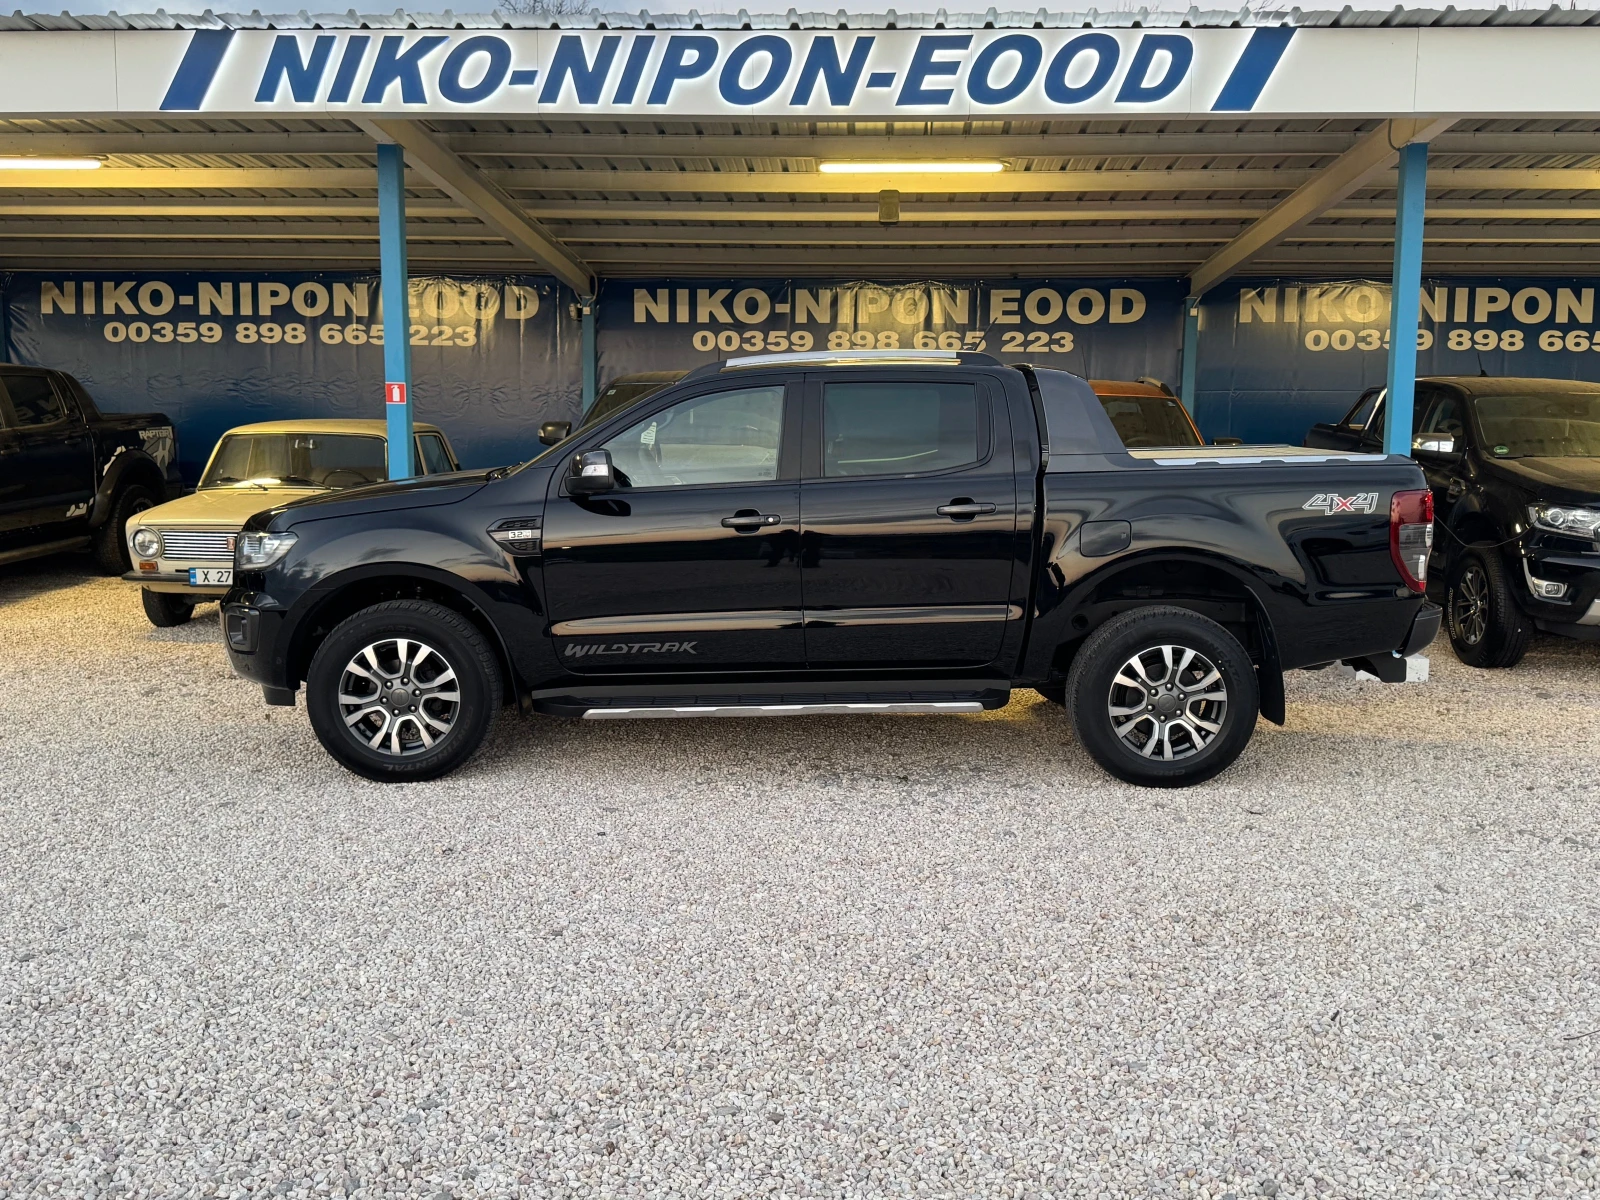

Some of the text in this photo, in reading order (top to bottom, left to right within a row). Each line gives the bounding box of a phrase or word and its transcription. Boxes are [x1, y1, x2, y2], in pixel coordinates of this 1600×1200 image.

[254, 33, 1194, 106] NIKO-NIPON-EOOD
[41, 281, 369, 317] NIKO-NIPON
[634, 288, 1147, 325] NIKO-NIPON EOOD
[1239, 286, 1595, 324] NIKONIPON
[104, 321, 222, 343] 00359
[235, 322, 307, 344] 898
[409, 325, 477, 347] 223
[692, 330, 1074, 352] 00359 898 665 223
[1304, 329, 1434, 351] 0039
[1447, 329, 1525, 351] 898
[138, 430, 170, 440] RAPTOR
[564, 641, 698, 658] WILDTRAK
